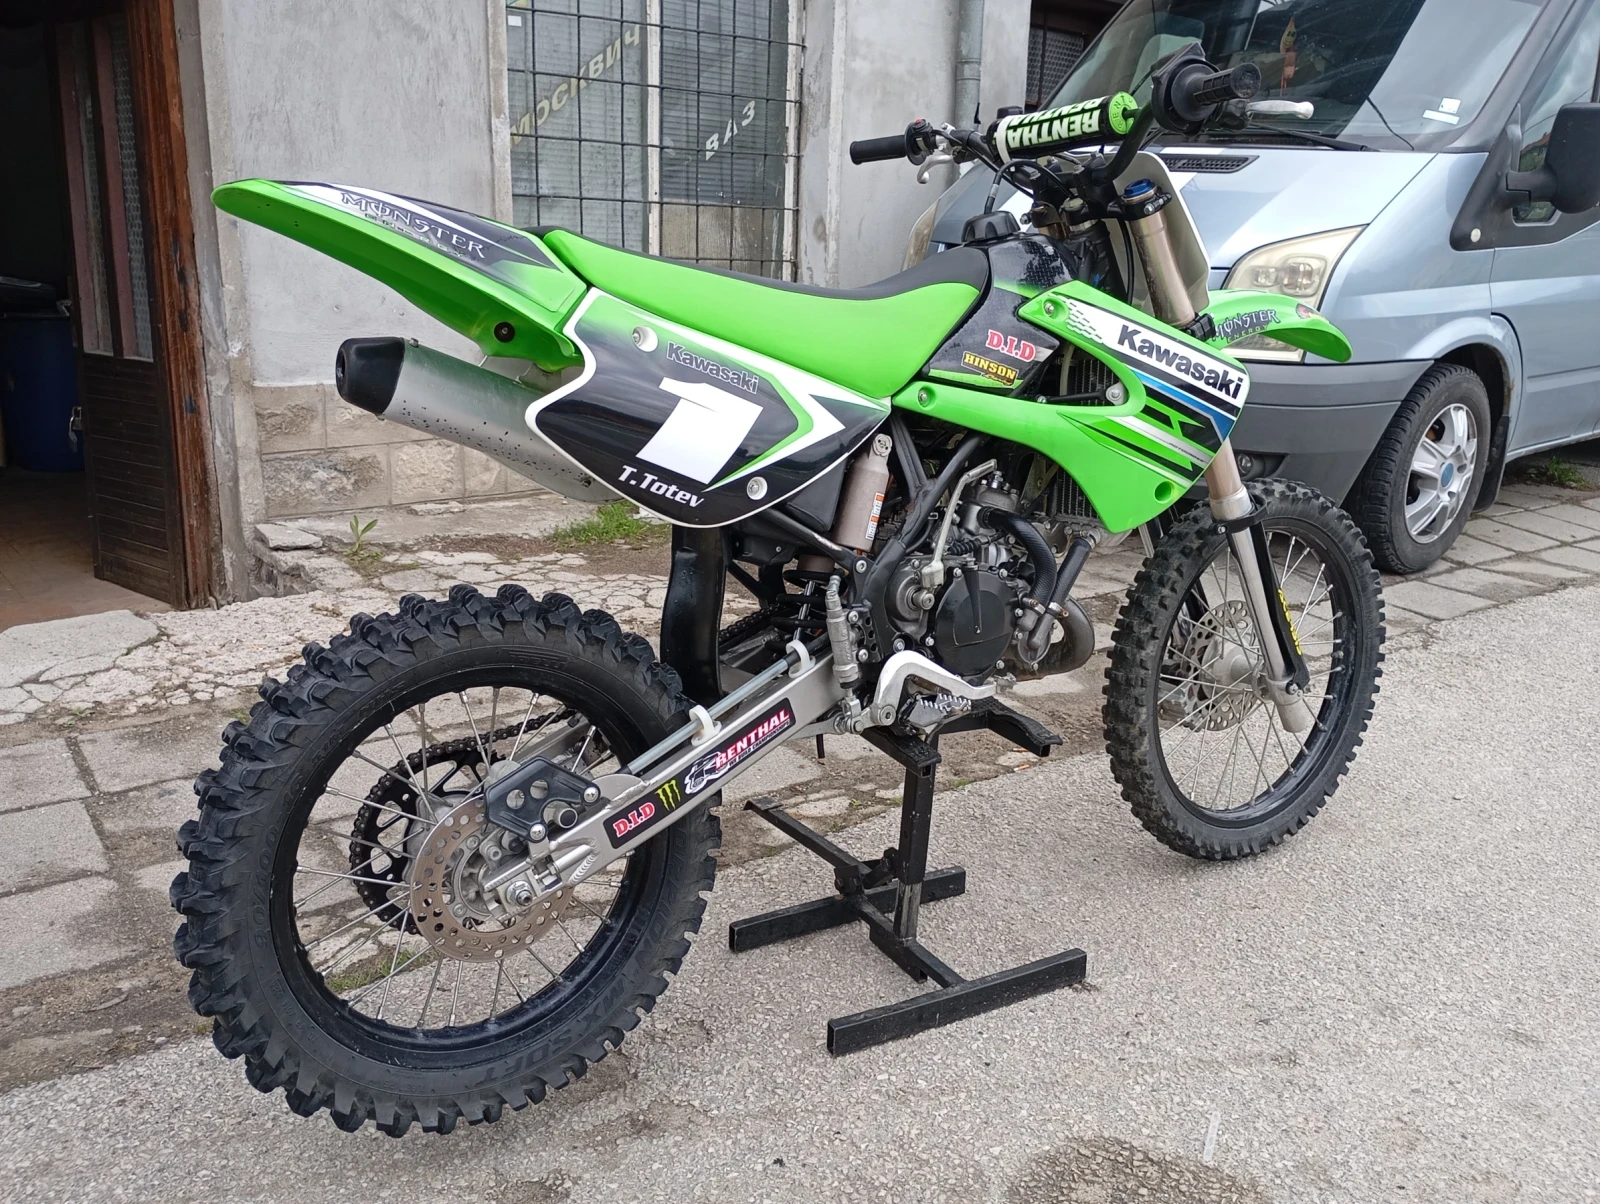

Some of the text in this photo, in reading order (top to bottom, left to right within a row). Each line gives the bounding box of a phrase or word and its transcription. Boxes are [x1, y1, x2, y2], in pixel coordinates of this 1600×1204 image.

[510, 25, 640, 146] МОСКВИЧ
[1006, 108, 1102, 149] RENTHA
[341, 192, 486, 259] MONSTER
[986, 329, 1036, 362] D.I.D
[1214, 309, 1280, 341] MONSTER
[1227, 325, 1268, 343] ENERGY
[667, 342, 759, 394] Kawasaki
[964, 353, 1017, 379] HINSON
[1117, 324, 1243, 400] Kawasaki
[635, 377, 763, 484] 1
[715, 709, 790, 771] RENTHAL
[612, 802, 655, 838] D.I.D
